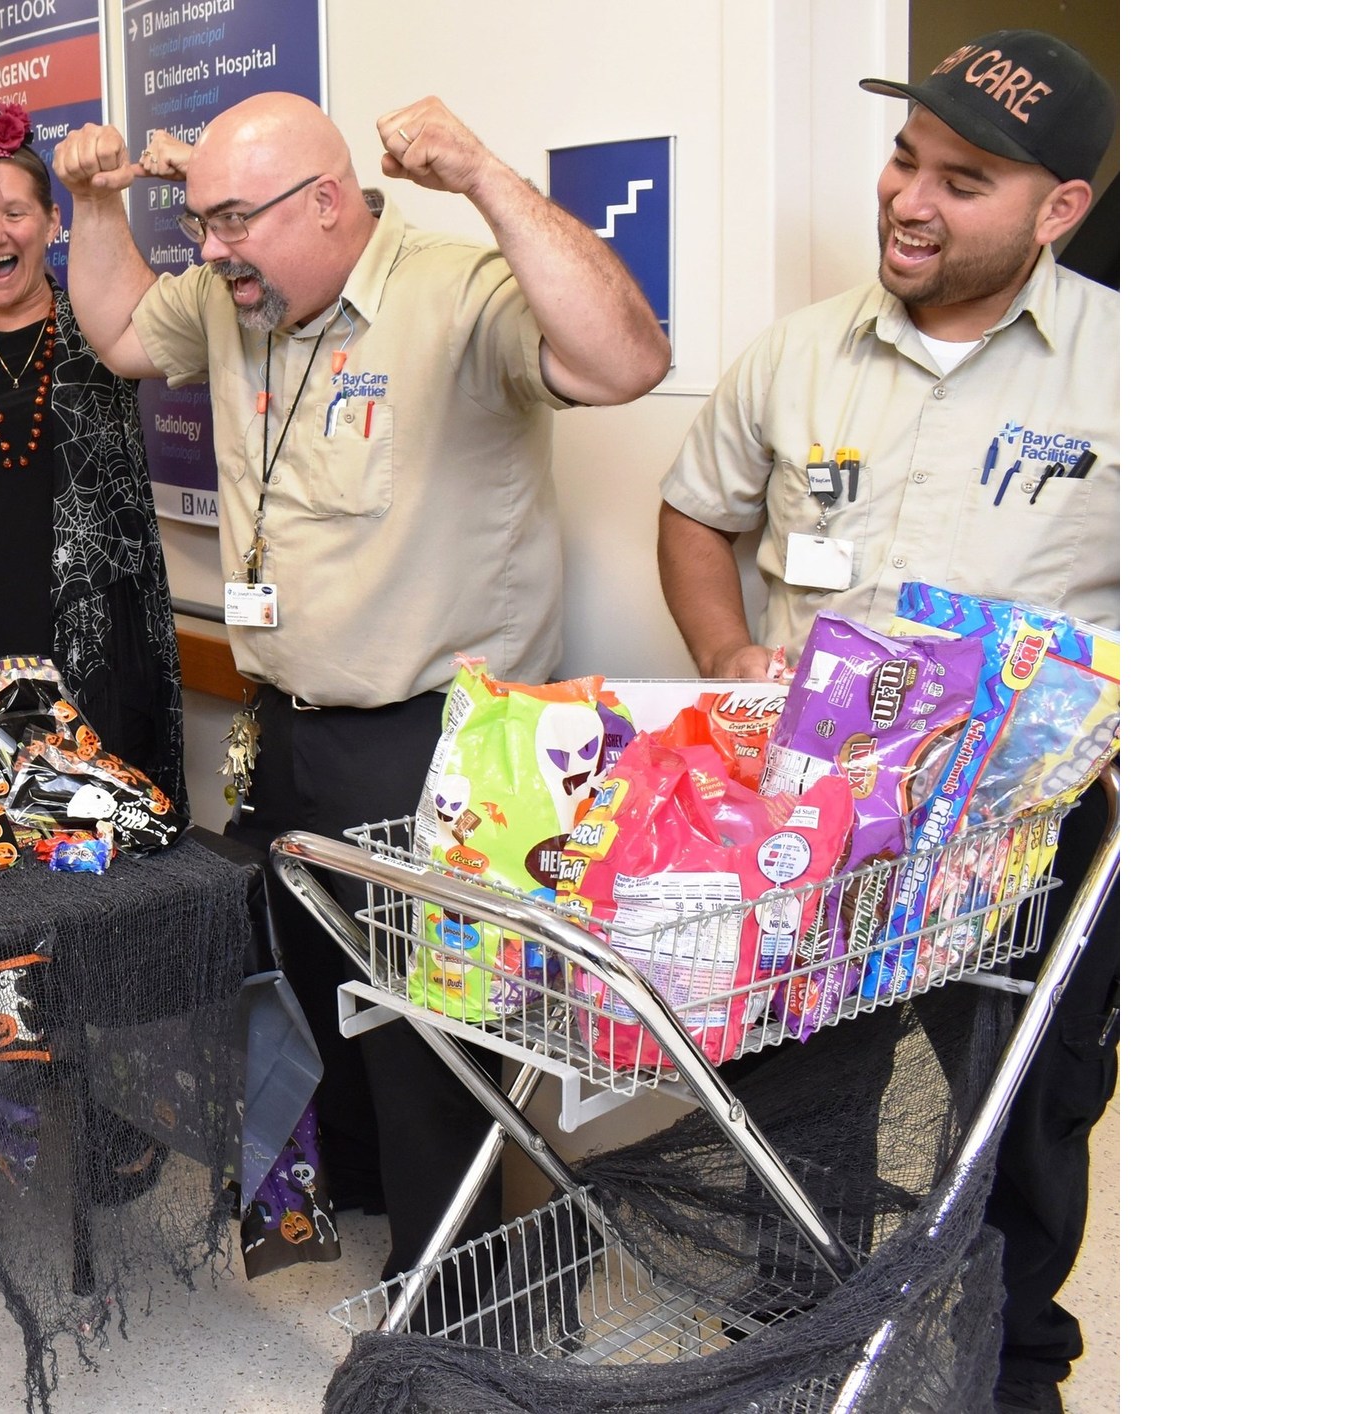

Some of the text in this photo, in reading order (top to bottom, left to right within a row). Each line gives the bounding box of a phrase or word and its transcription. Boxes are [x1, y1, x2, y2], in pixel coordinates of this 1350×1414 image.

[7, 0, 56, 27] FLOOR
[155, 0, 234, 31] Main Hospital
[182, 23, 225, 53] principal
[156, 44, 276, 90] Children's Hospital
[965, 50, 1053, 124] CARE
[184, 86, 219, 112] infantil
[36, 122, 69, 141] Tower
[173, 186, 185, 204] Pa
[151, 244, 194, 266] Admitting
[342, 373, 388, 388] BayCare
[343, 385, 386, 397] Facilities
[155, 415, 201, 441] Radiology
[1022, 430, 1091, 451] BayCare
[1021, 445, 1083, 465] Facilitie
[197, 498, 218, 517] MA
[961, 720, 985, 754] Select
[451, 852, 485, 869] Reese's
[695, 902, 703, 910] 45
